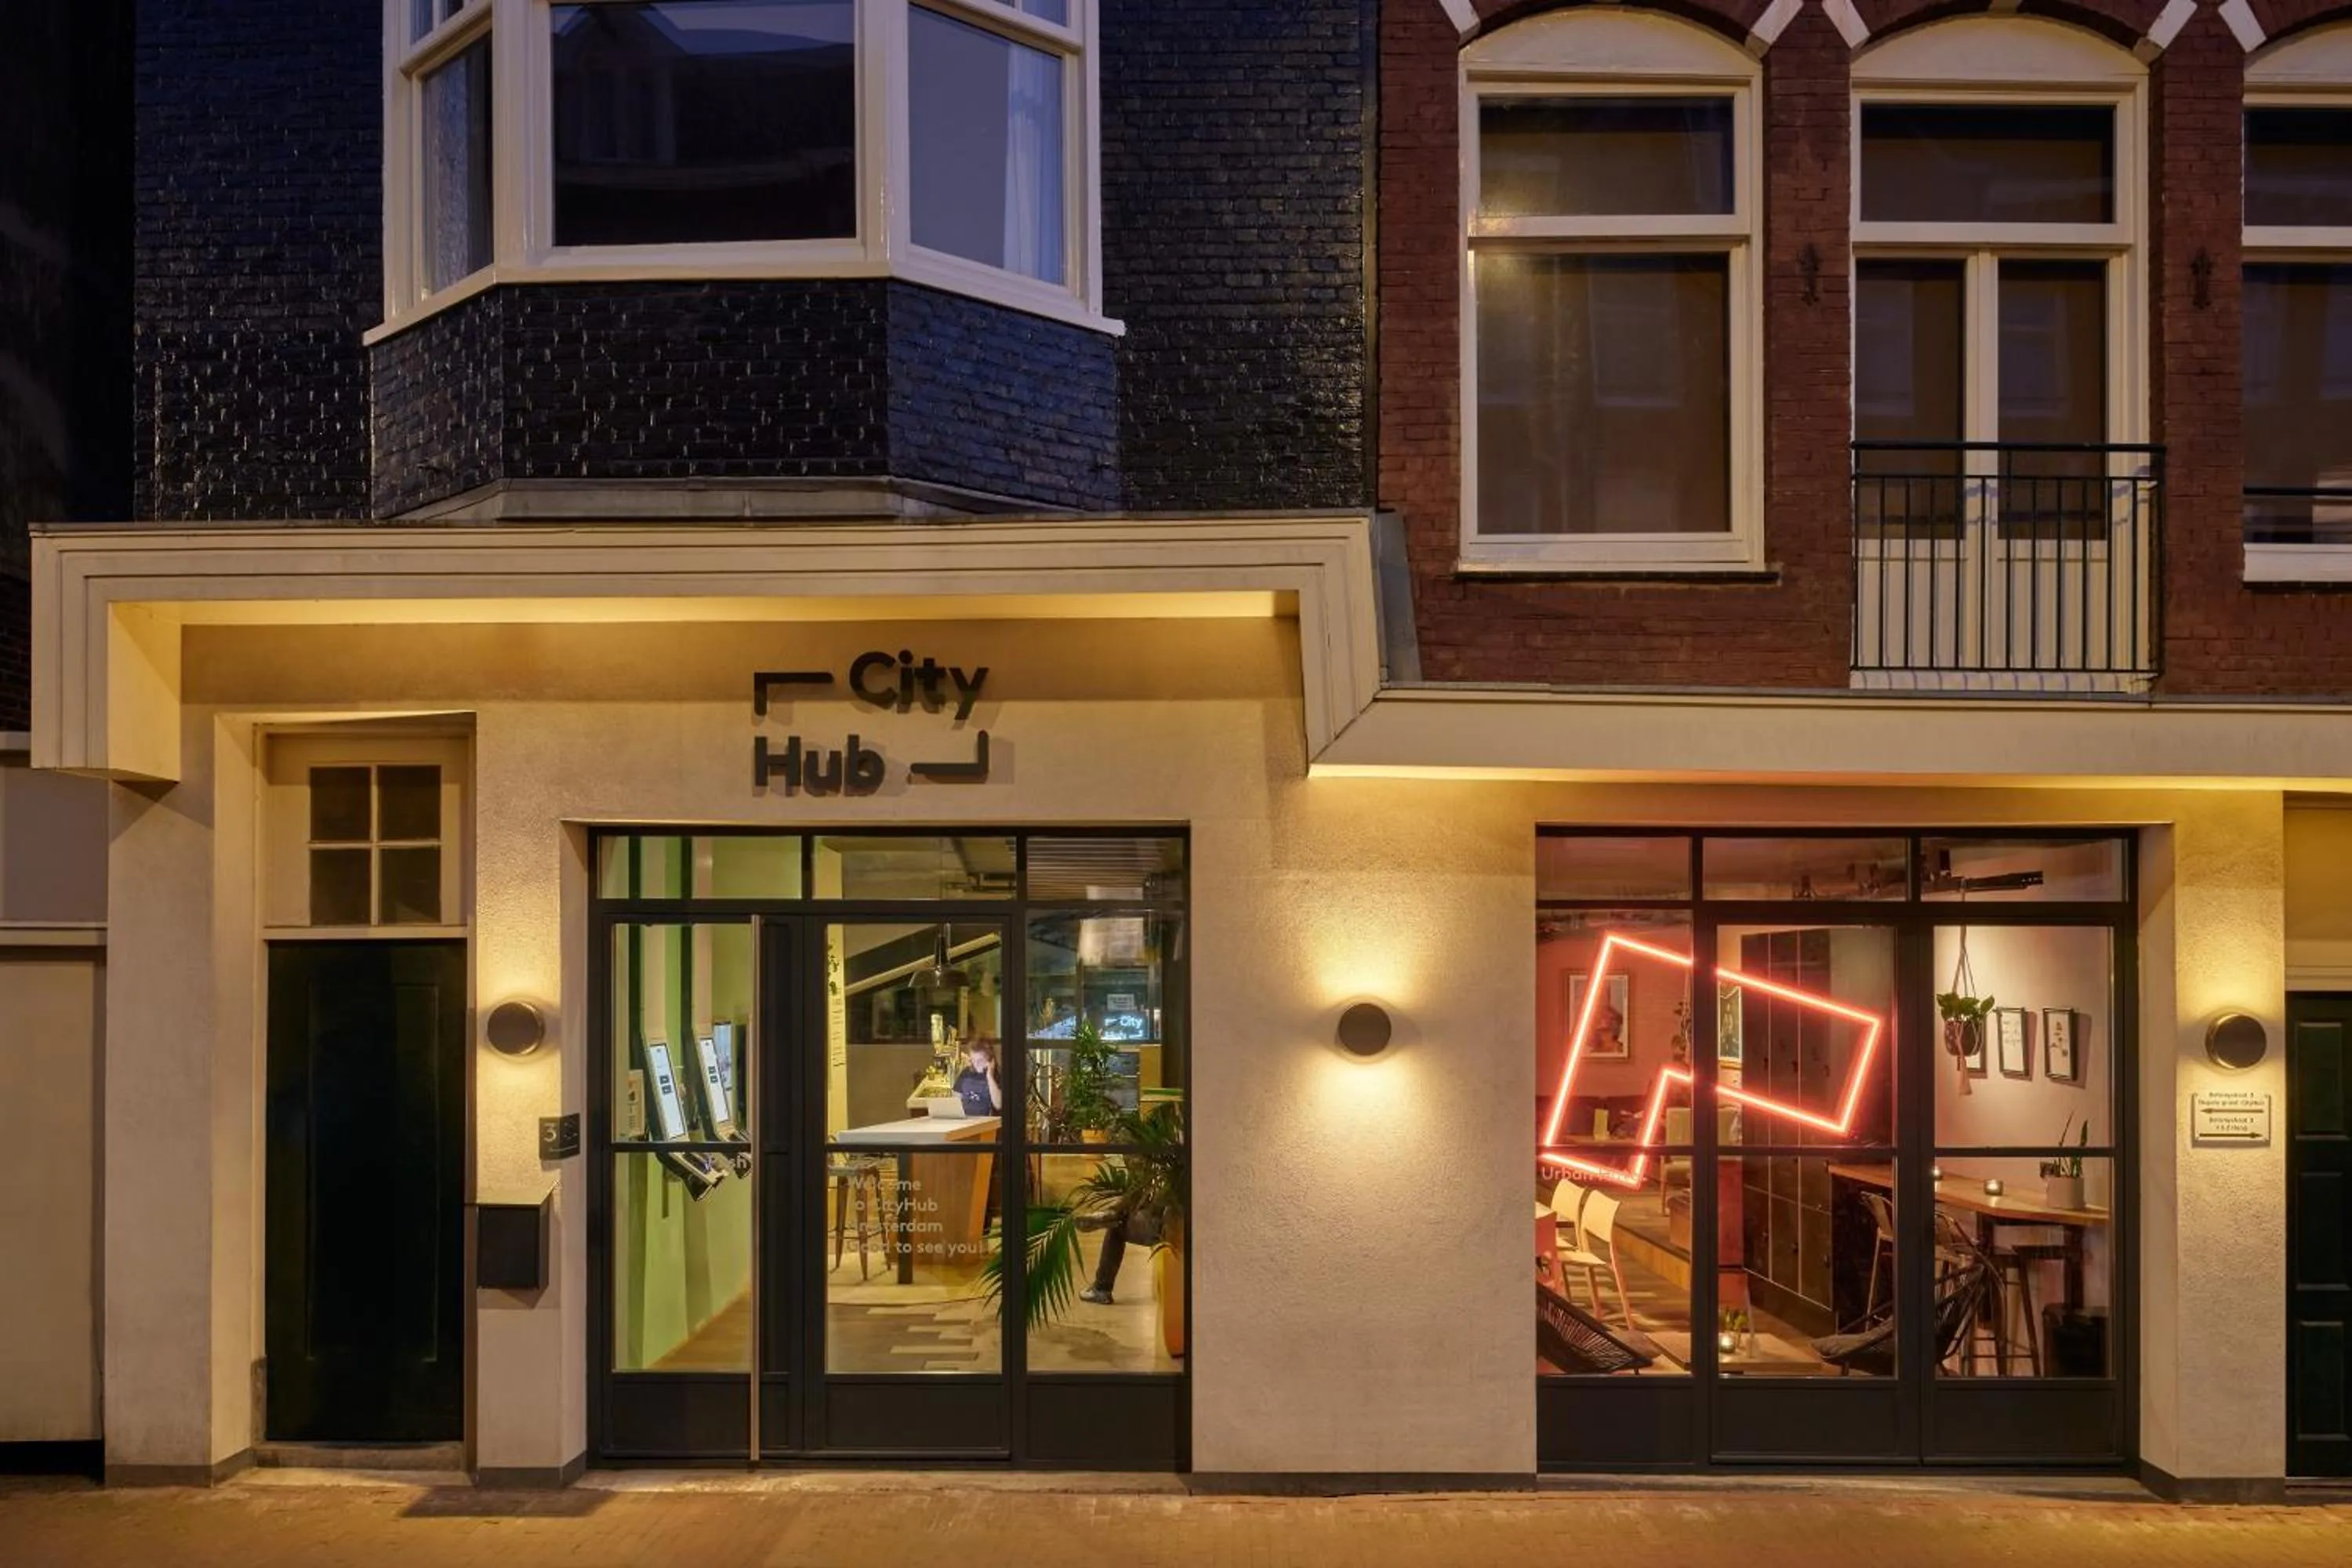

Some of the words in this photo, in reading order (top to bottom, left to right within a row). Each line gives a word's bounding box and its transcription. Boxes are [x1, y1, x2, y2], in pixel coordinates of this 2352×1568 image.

[849, 649, 989, 720] City
[754, 735, 885, 787] Hub
[543, 1123, 557, 1142] 3
[896, 1241, 913, 1254] to
[916, 1243, 944, 1254] see
